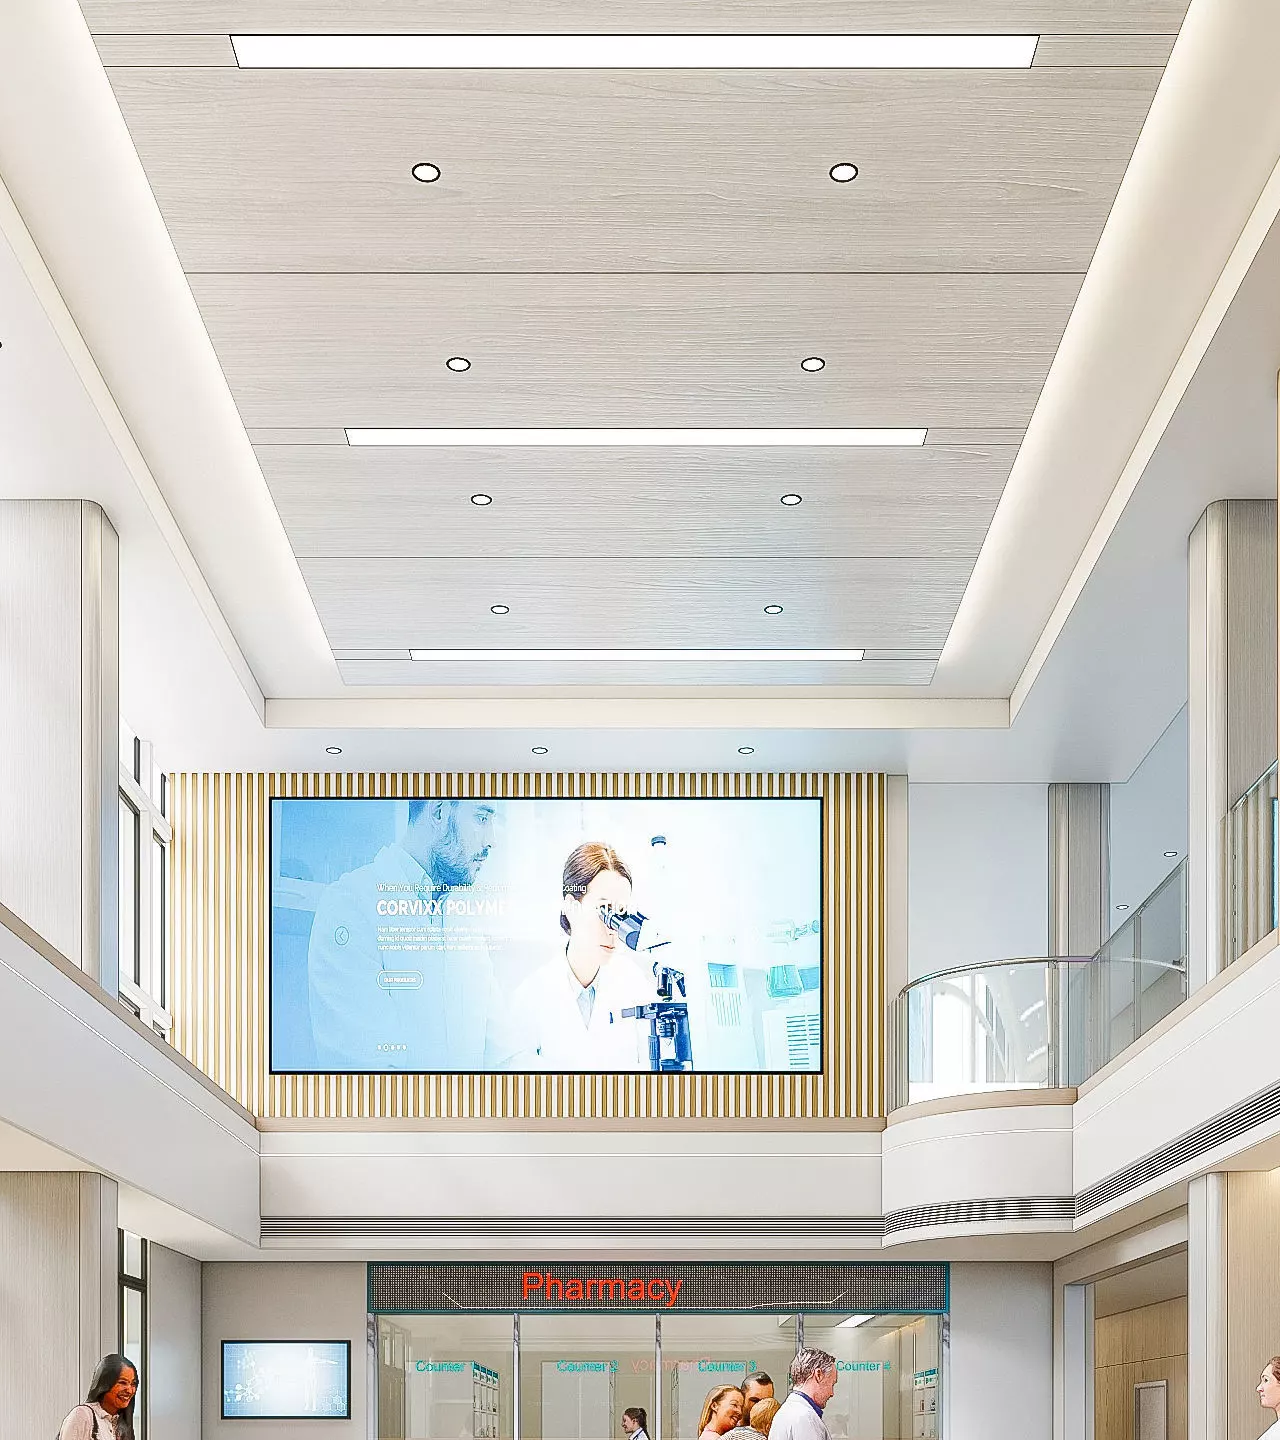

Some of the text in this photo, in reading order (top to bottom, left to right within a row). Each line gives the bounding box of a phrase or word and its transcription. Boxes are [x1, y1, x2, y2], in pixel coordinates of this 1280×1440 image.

[376, 884, 399, 892] When
[400, 884, 414, 892] You
[415, 884, 441, 893] Require
[376, 899, 443, 916] CORVIXX
[522, 1271, 683, 1307] Pharmacy
[415, 1360, 465, 1373] Counter
[556, 1360, 608, 1373] Counter
[698, 1360, 757, 1373] Counter 3
[836, 1360, 881, 1372] Counter
